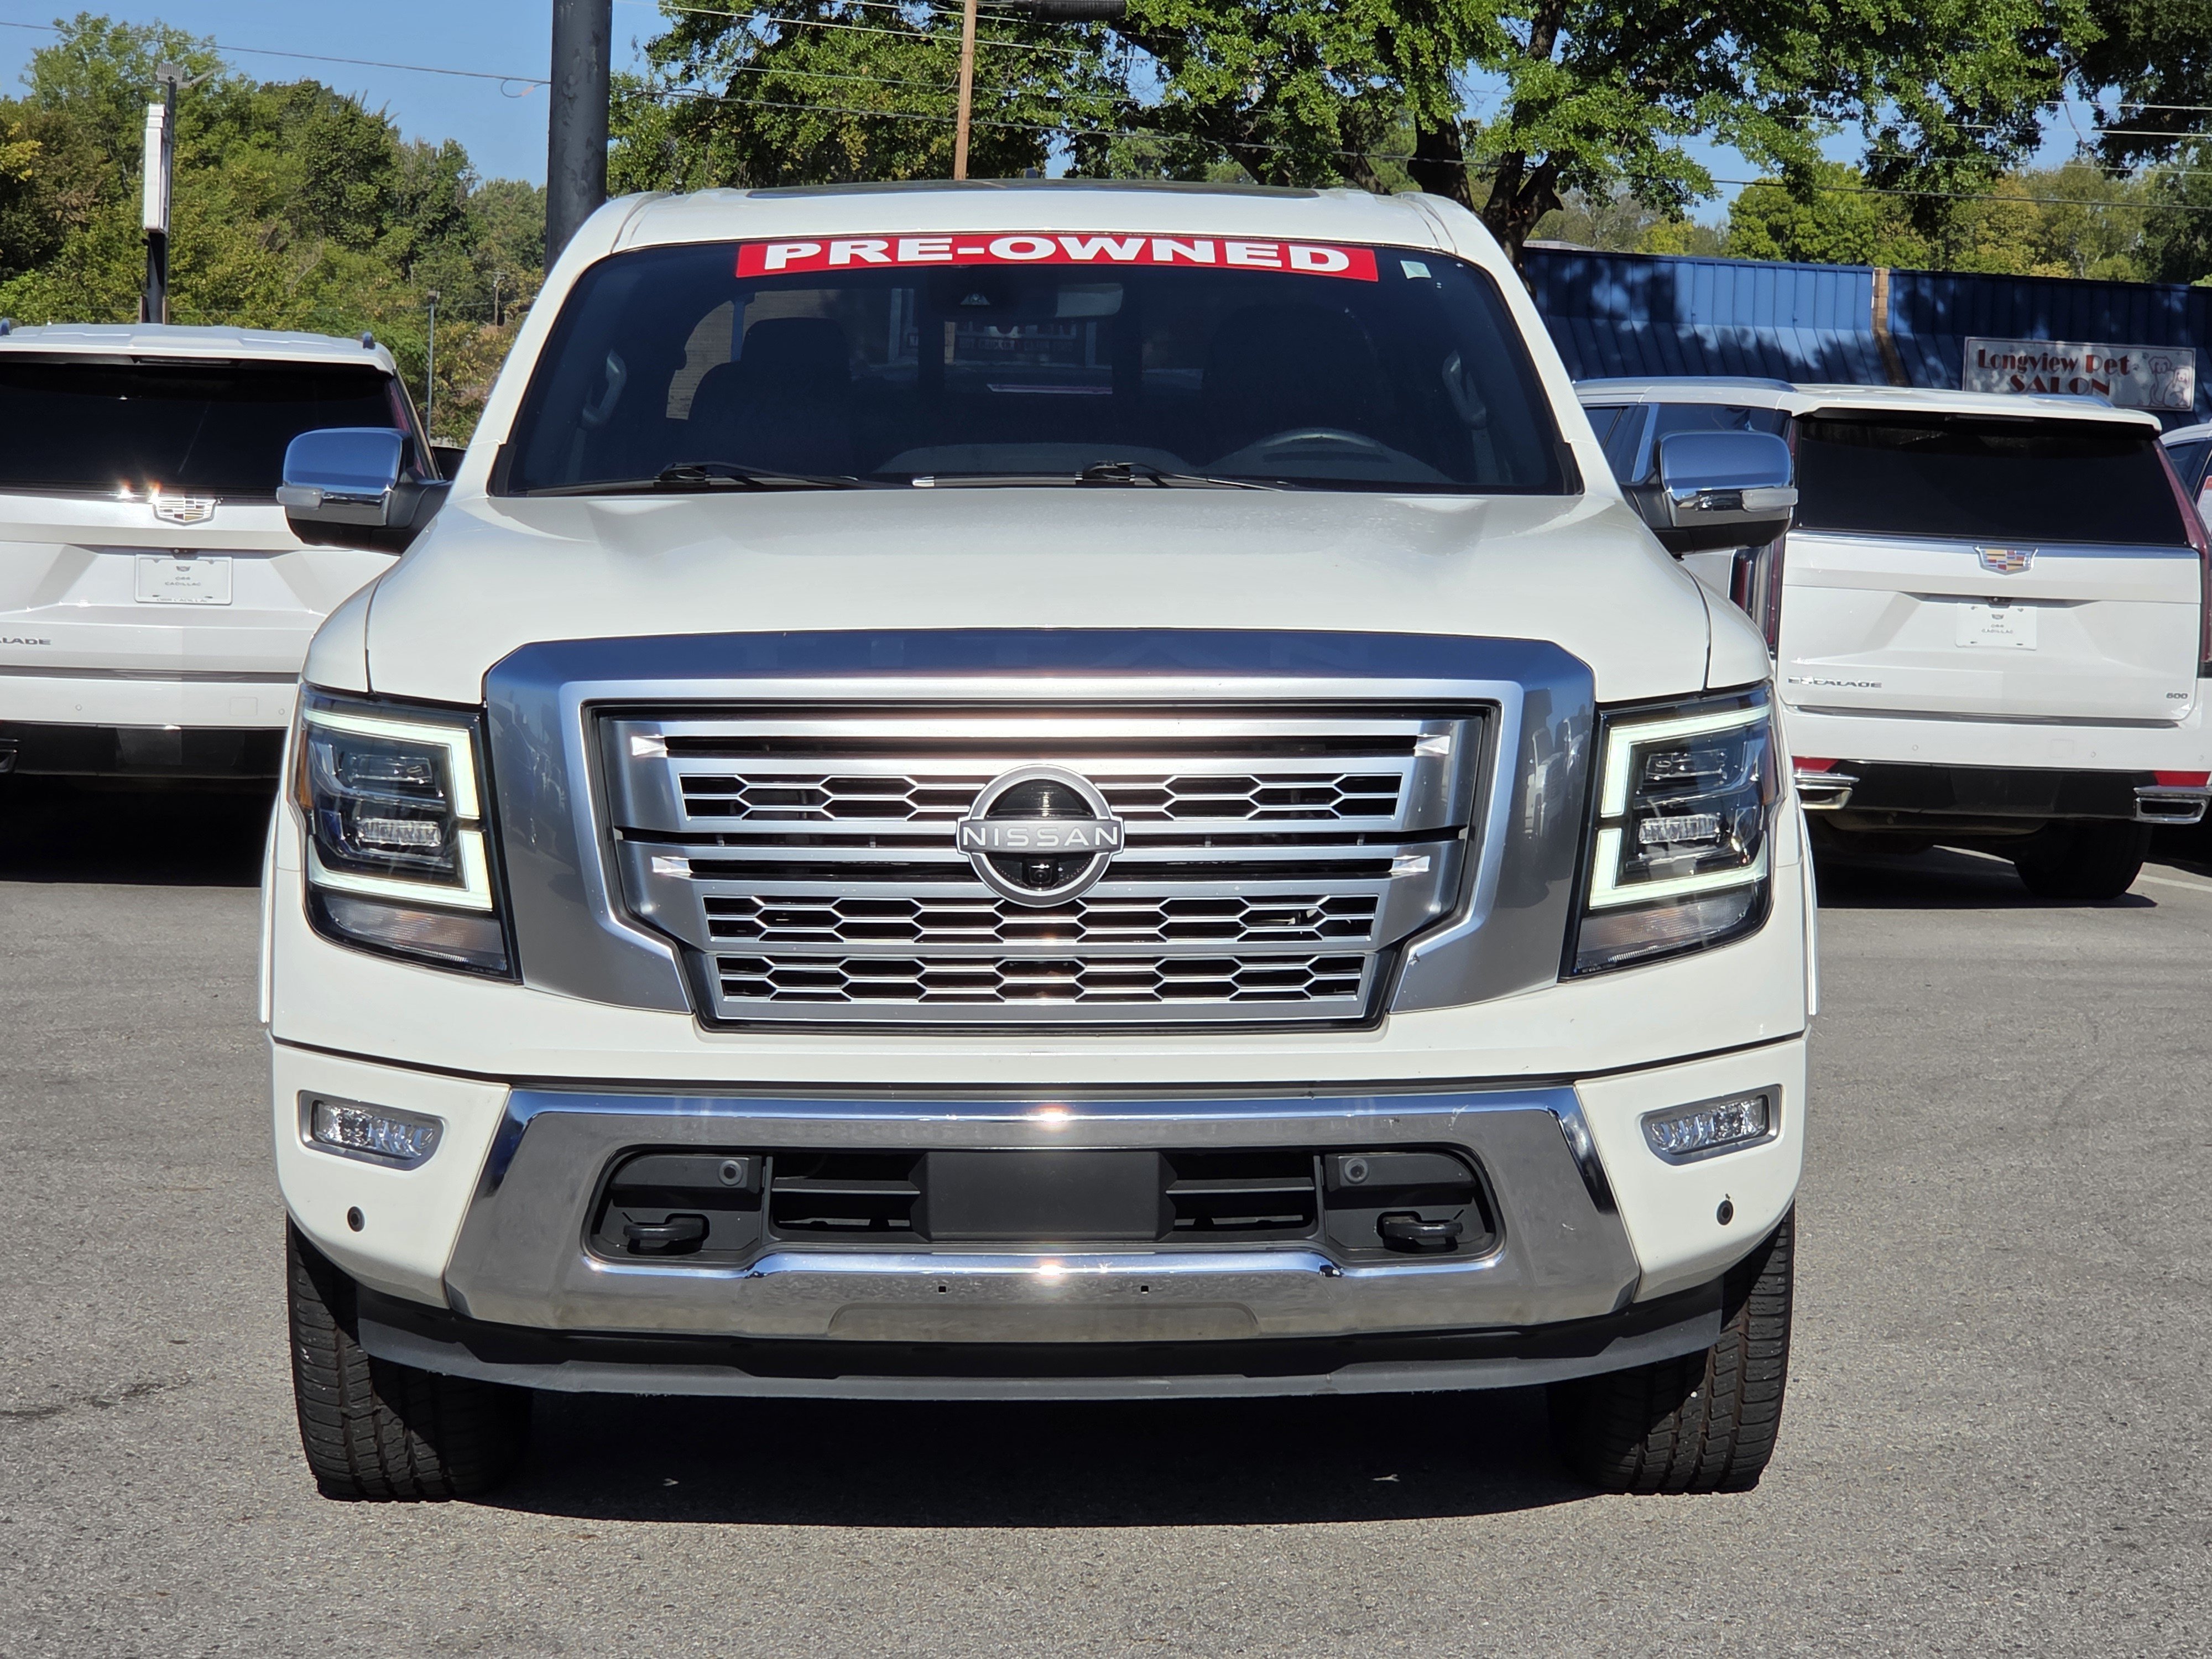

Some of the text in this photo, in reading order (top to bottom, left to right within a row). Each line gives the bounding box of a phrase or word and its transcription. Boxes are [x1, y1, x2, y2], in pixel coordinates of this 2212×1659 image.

[764, 236, 1349, 273] PRE-OWNED
[1978, 348, 2131, 375] Longview Pet
[2009, 374, 2111, 396] SALON
[0, 637, 51, 646] LADE
[962, 826, 1118, 847] NISSAN
